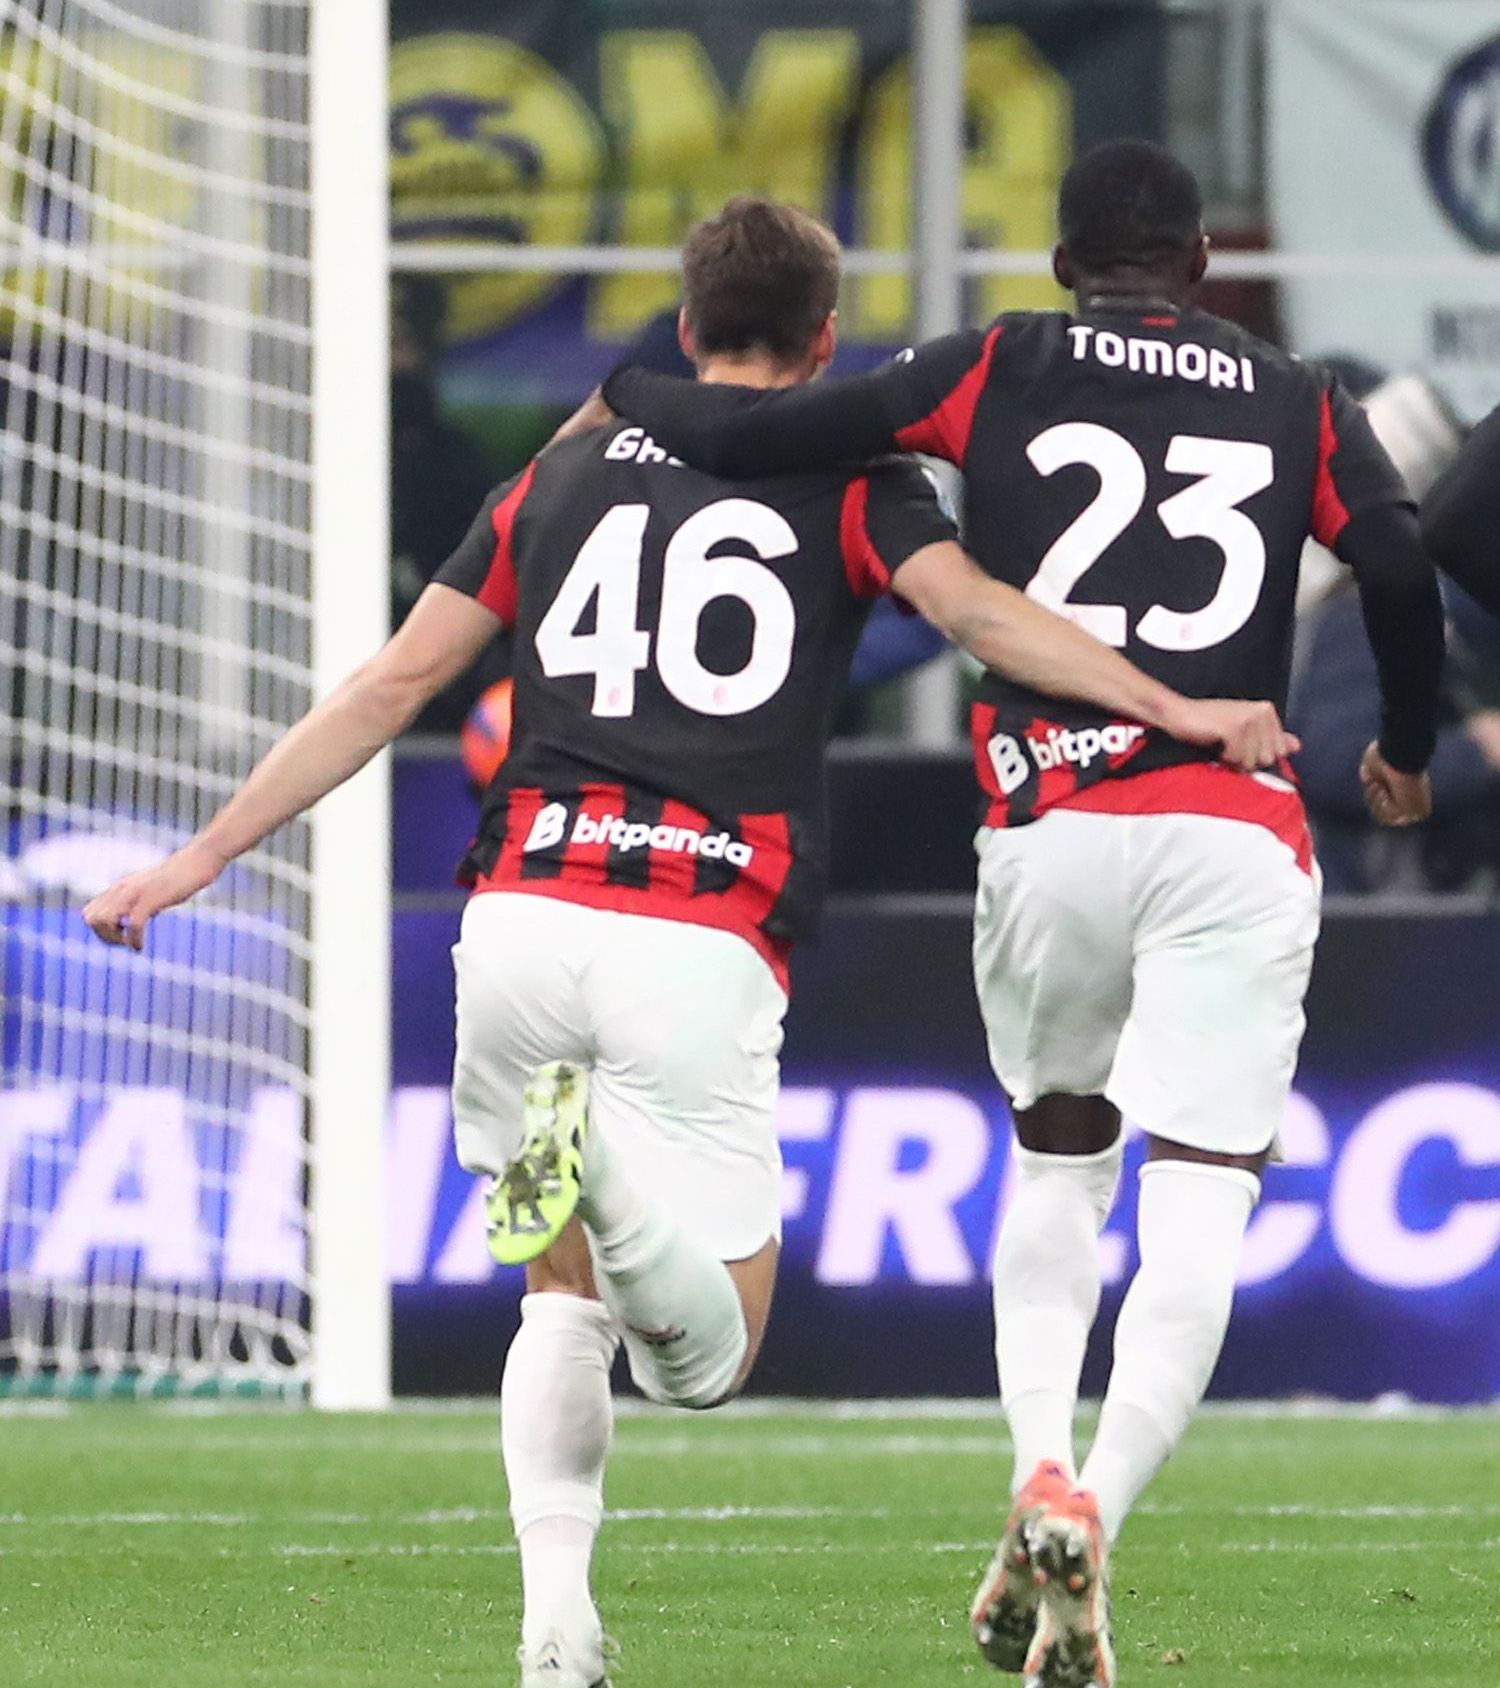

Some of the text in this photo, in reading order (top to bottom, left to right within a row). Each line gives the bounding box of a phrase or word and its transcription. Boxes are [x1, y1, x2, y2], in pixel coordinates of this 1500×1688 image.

[1066, 325, 1256, 394] TOMORI
[1025, 421, 1275, 653] 23
[534, 497, 800, 718] 46
[1026, 725, 1145, 769] bitpa
[569, 812, 754, 868] bitpanda
[0, 1086, 508, 1284] TALI
